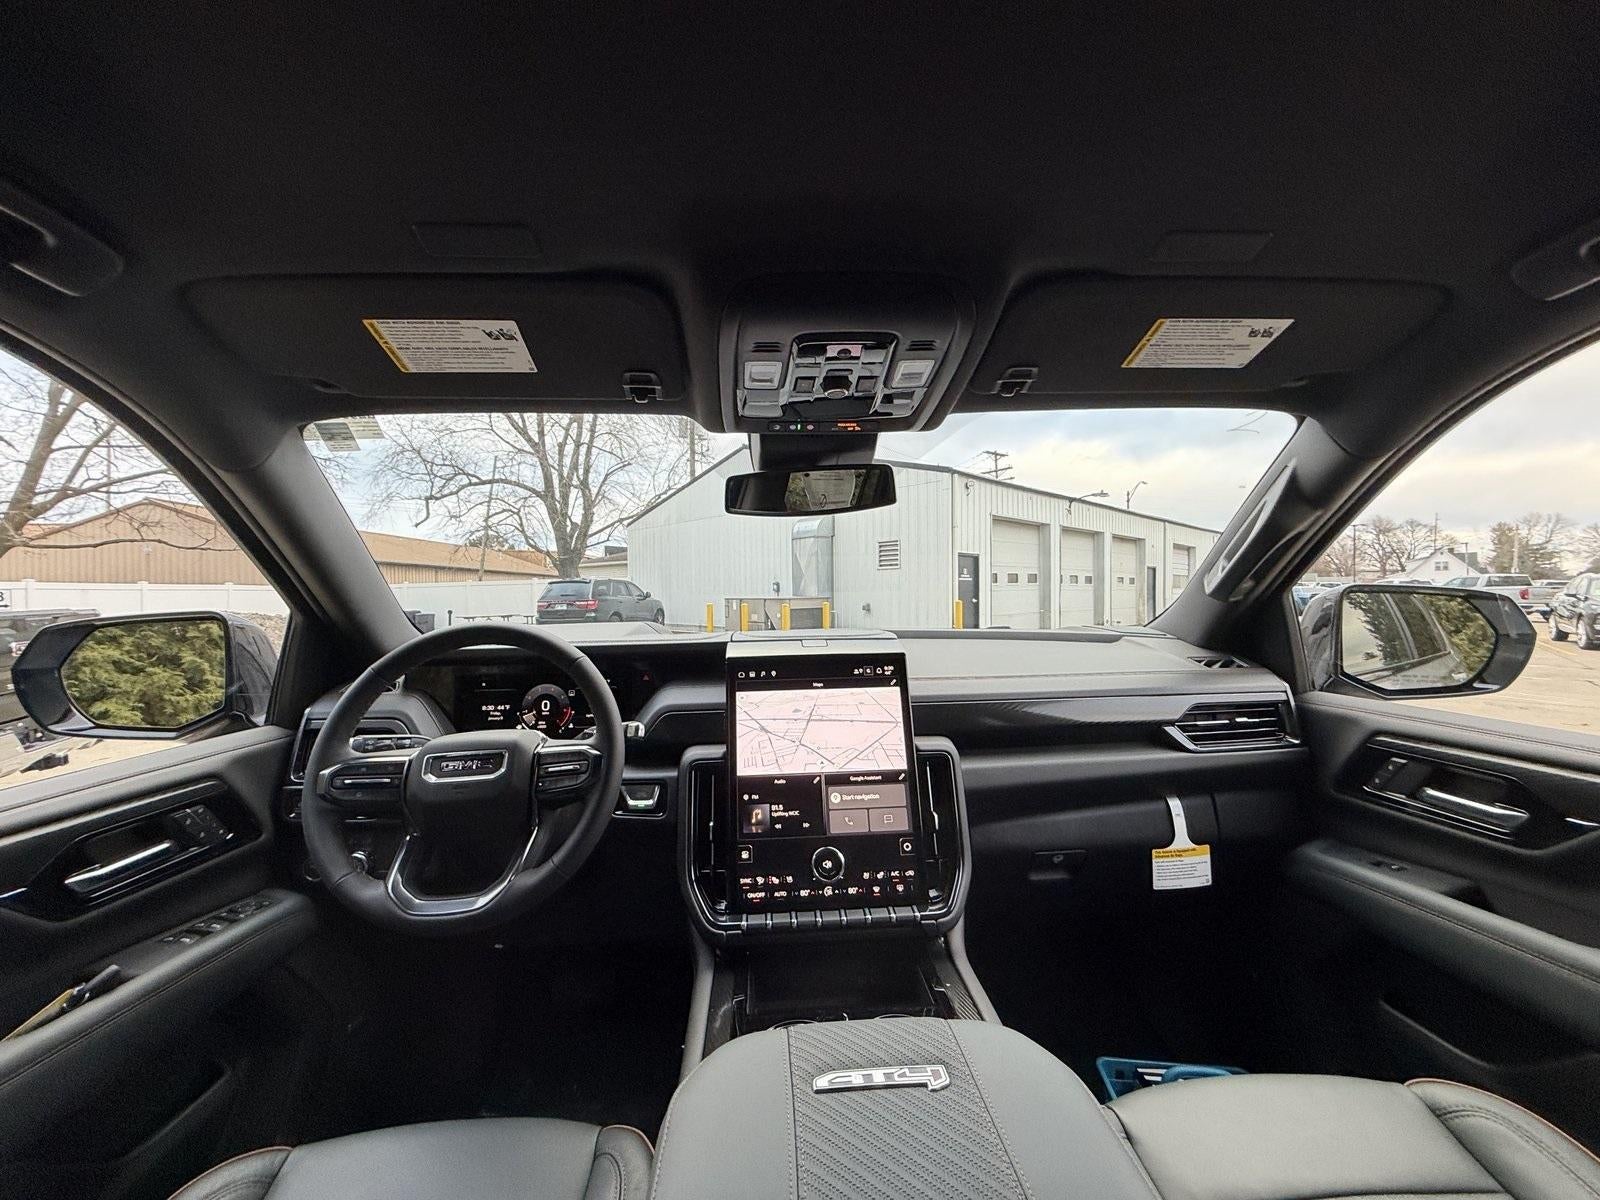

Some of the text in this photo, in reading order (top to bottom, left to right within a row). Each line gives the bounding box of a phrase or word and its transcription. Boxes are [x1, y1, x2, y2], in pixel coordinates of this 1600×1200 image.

[541, 700, 550, 711] 0
[441, 760, 493, 772] GMC
[854, 793, 880, 801] navigation
